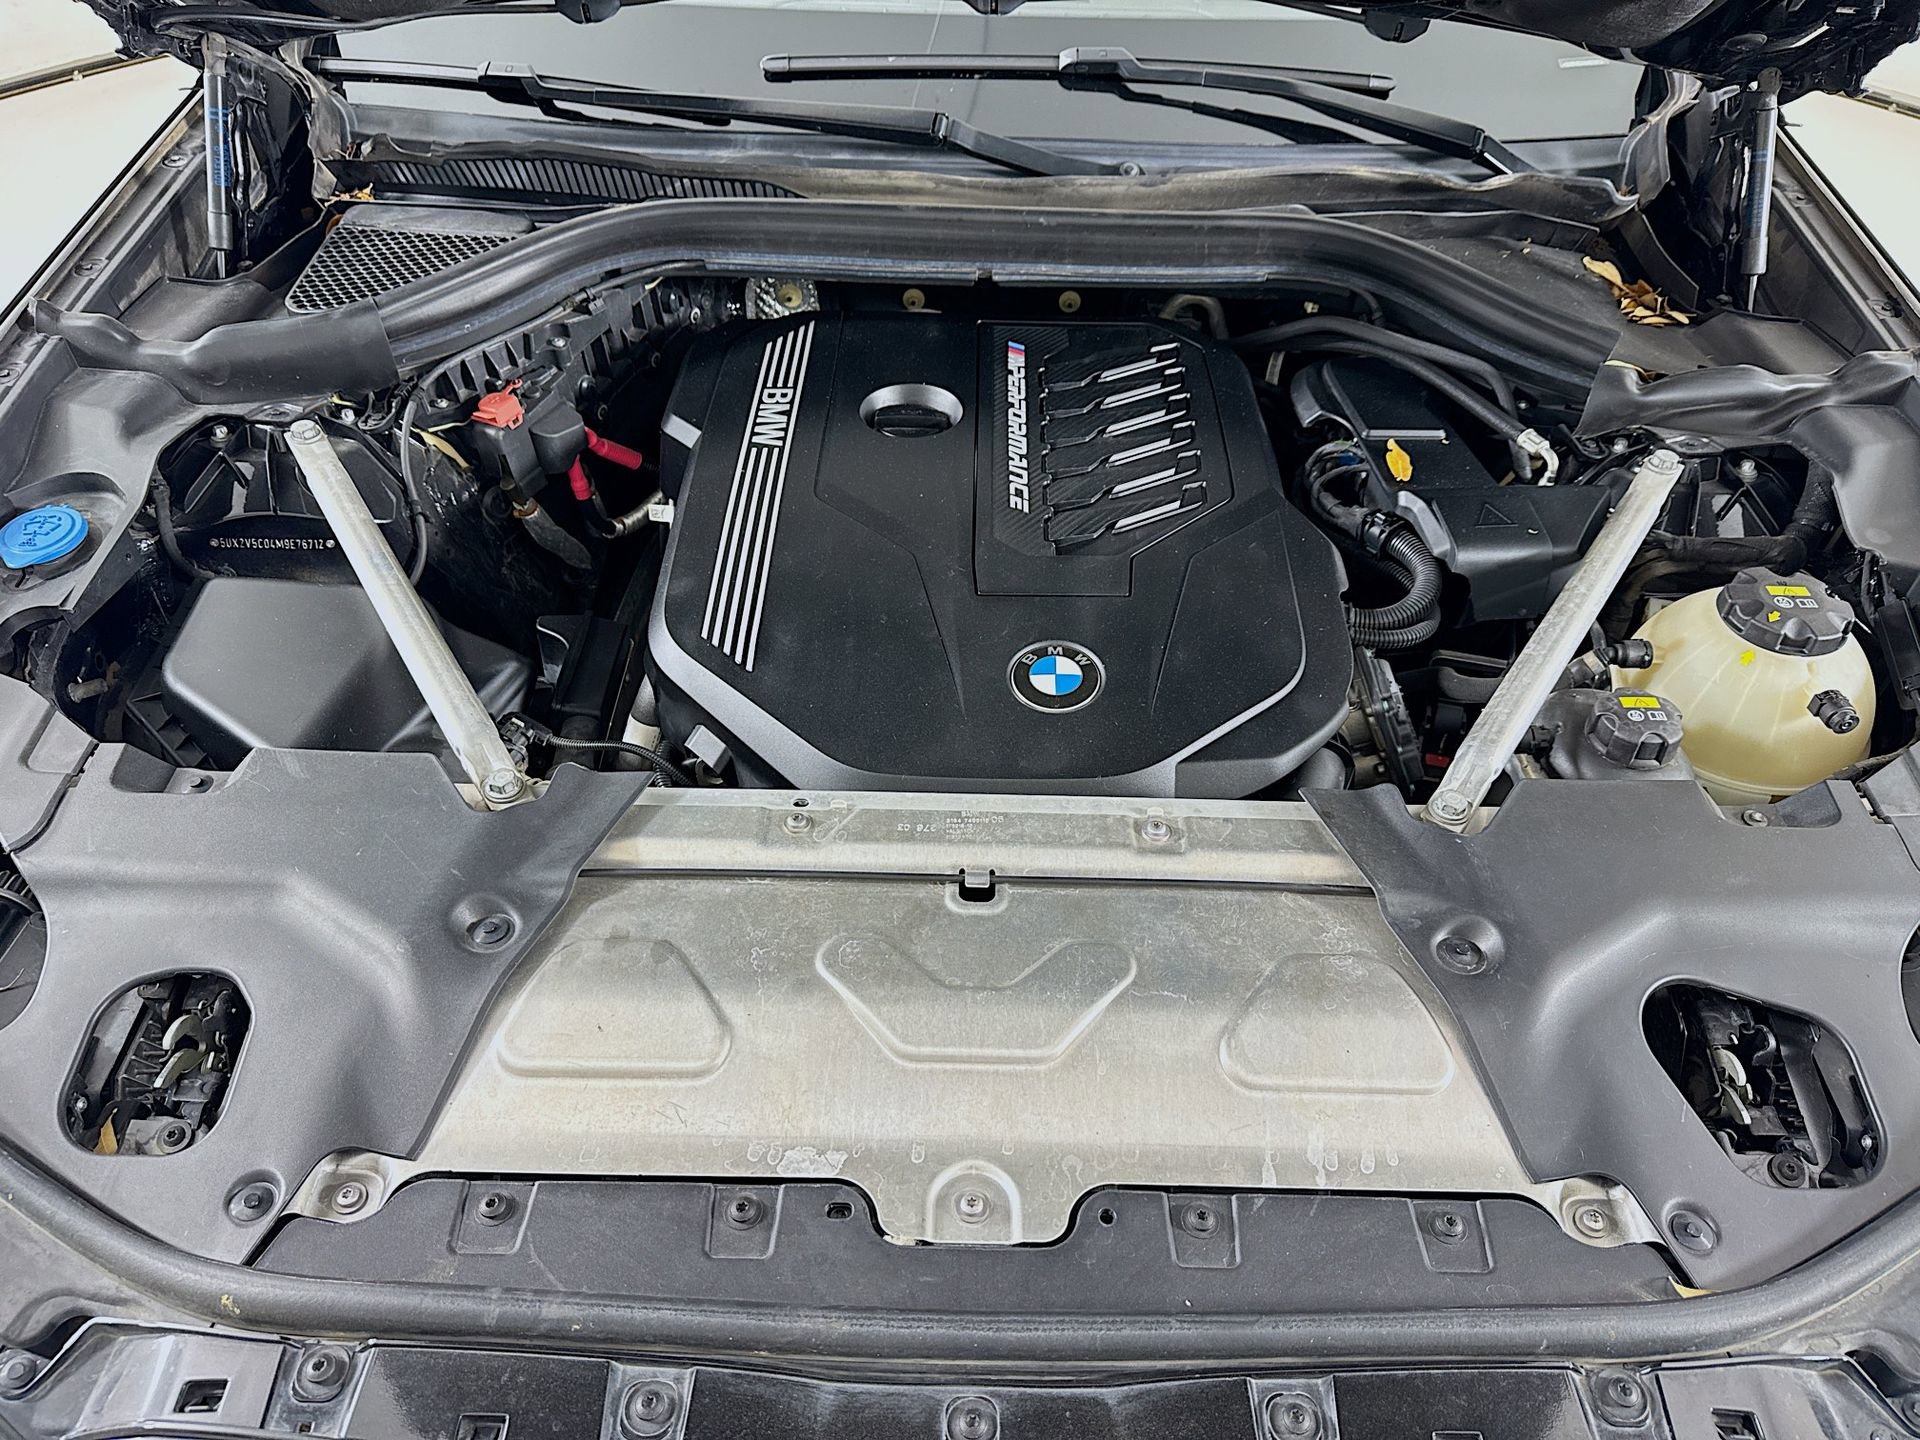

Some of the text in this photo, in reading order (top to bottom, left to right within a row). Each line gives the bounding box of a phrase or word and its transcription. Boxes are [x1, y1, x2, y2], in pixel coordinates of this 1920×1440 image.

[751, 388, 794, 447] BMW
[1008, 363, 1029, 514] PERFORMANCE
[1021, 646, 1091, 666] BMW
